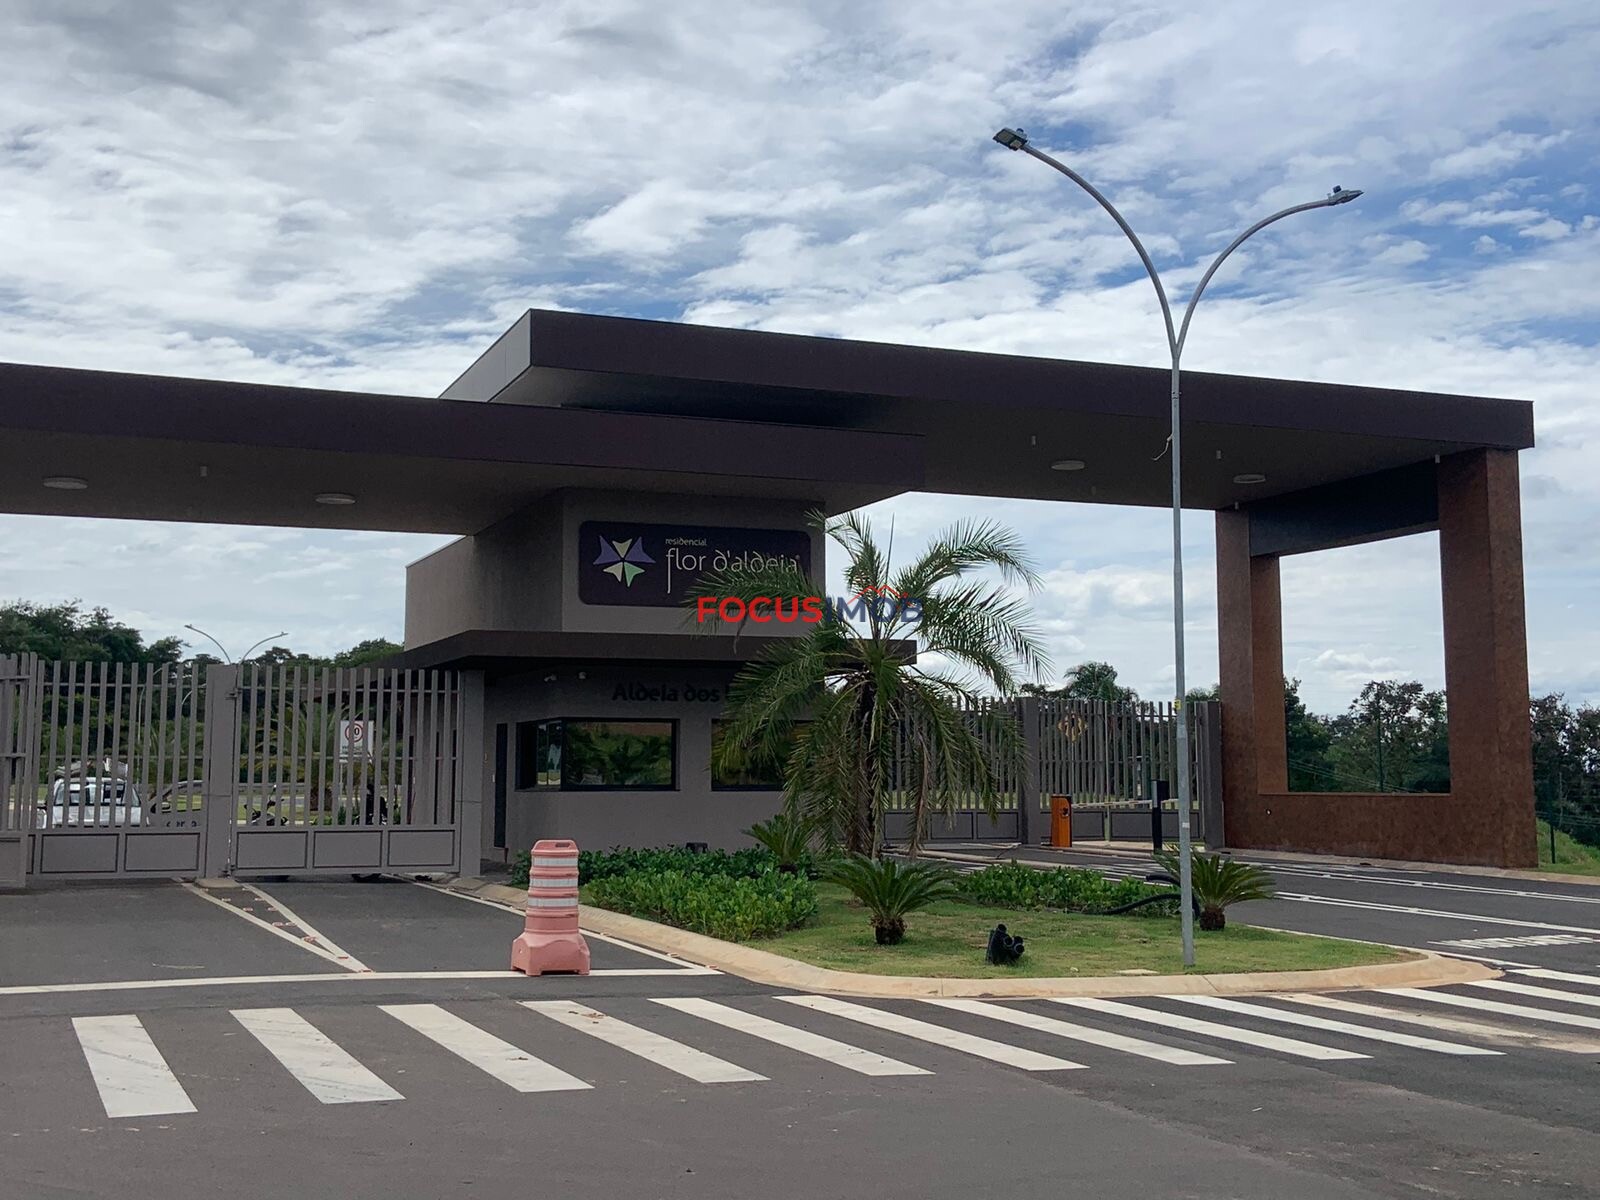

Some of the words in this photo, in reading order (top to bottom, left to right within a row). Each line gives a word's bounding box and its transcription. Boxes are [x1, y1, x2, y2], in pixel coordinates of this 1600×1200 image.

[665, 537, 707, 546] residencial
[665, 548, 706, 594] flor
[713, 549, 798, 573] d'aldeia
[612, 682, 678, 702] Aldeia
[684, 684, 720, 703] dos
